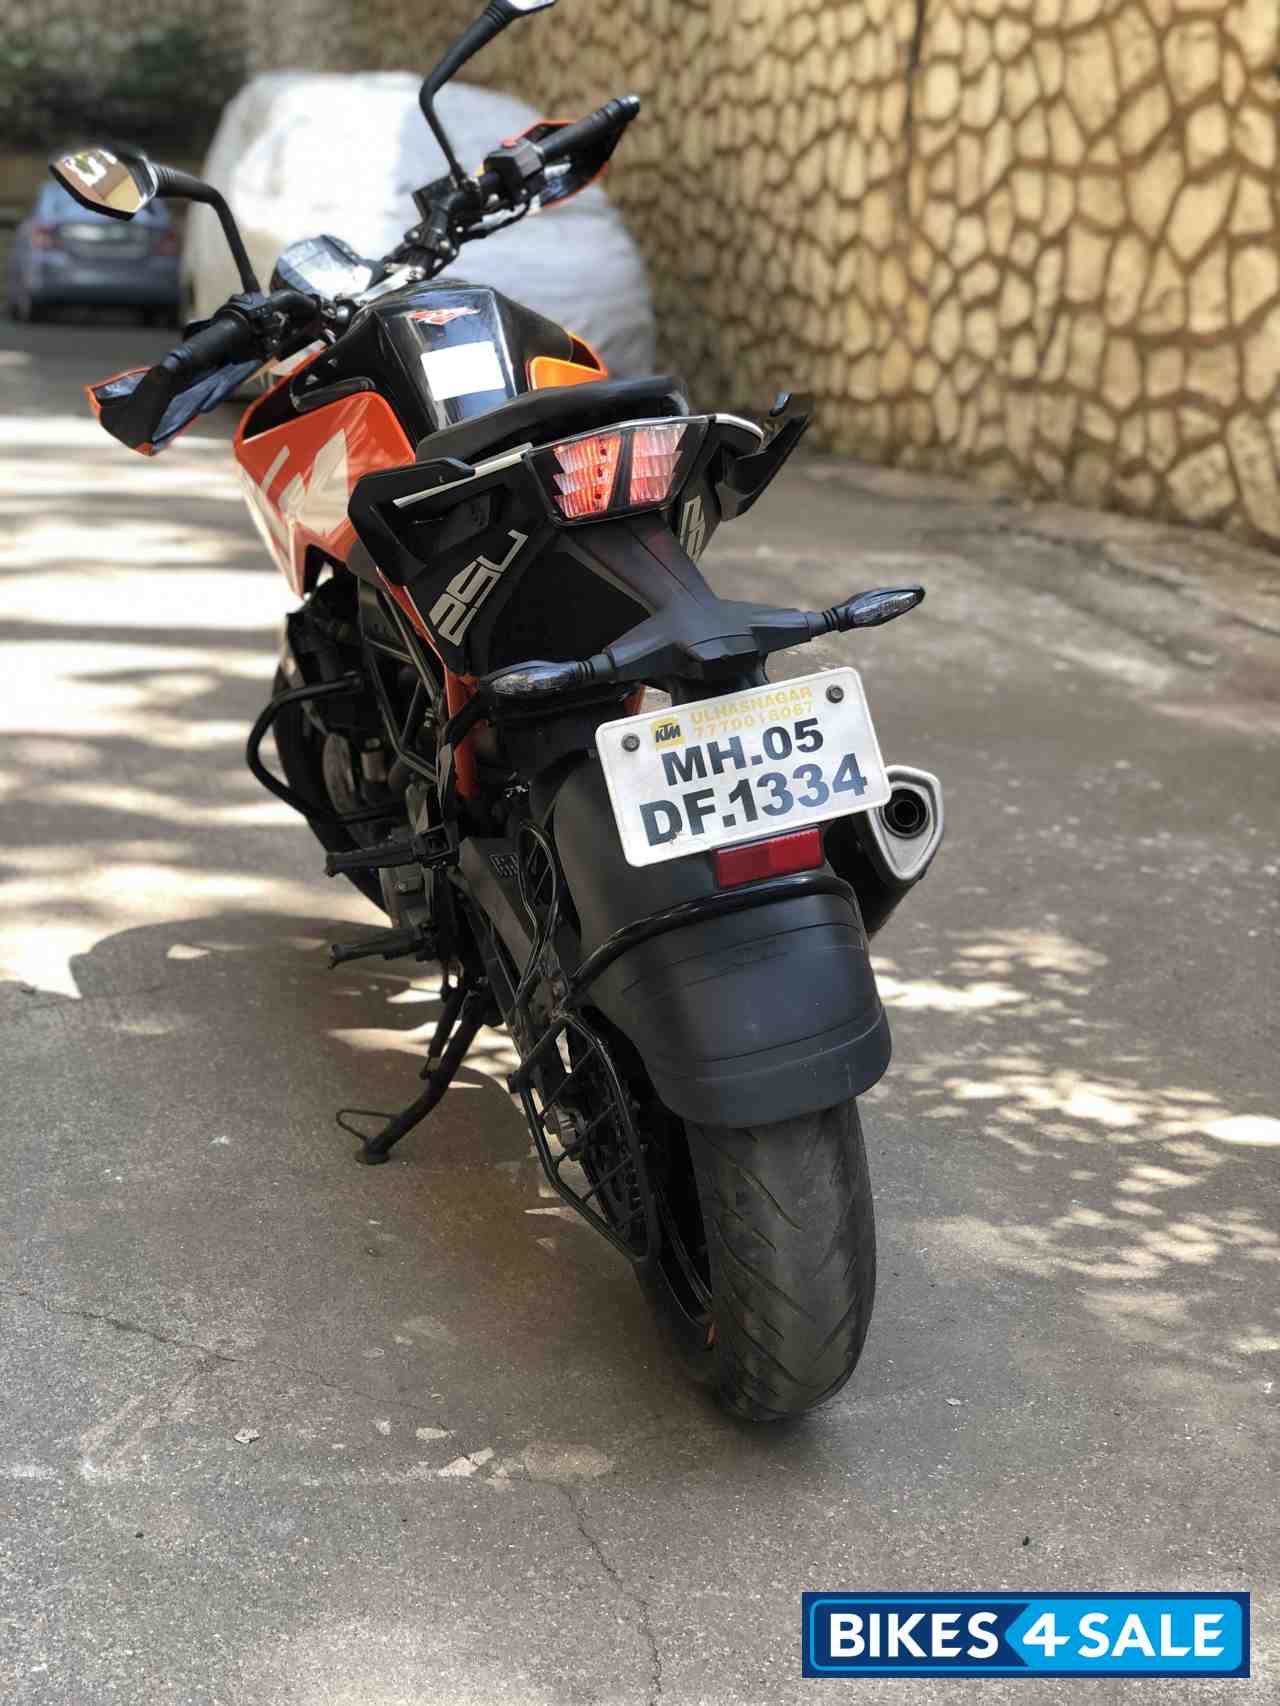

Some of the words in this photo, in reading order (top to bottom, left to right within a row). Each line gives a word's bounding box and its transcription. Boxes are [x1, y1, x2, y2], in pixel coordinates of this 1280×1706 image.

[689, 686, 813, 724] ULHASNAGAR
[654, 721, 682, 744] KTM
[661, 717, 824, 786] MH.05
[639, 752, 868, 847] DF.1334
